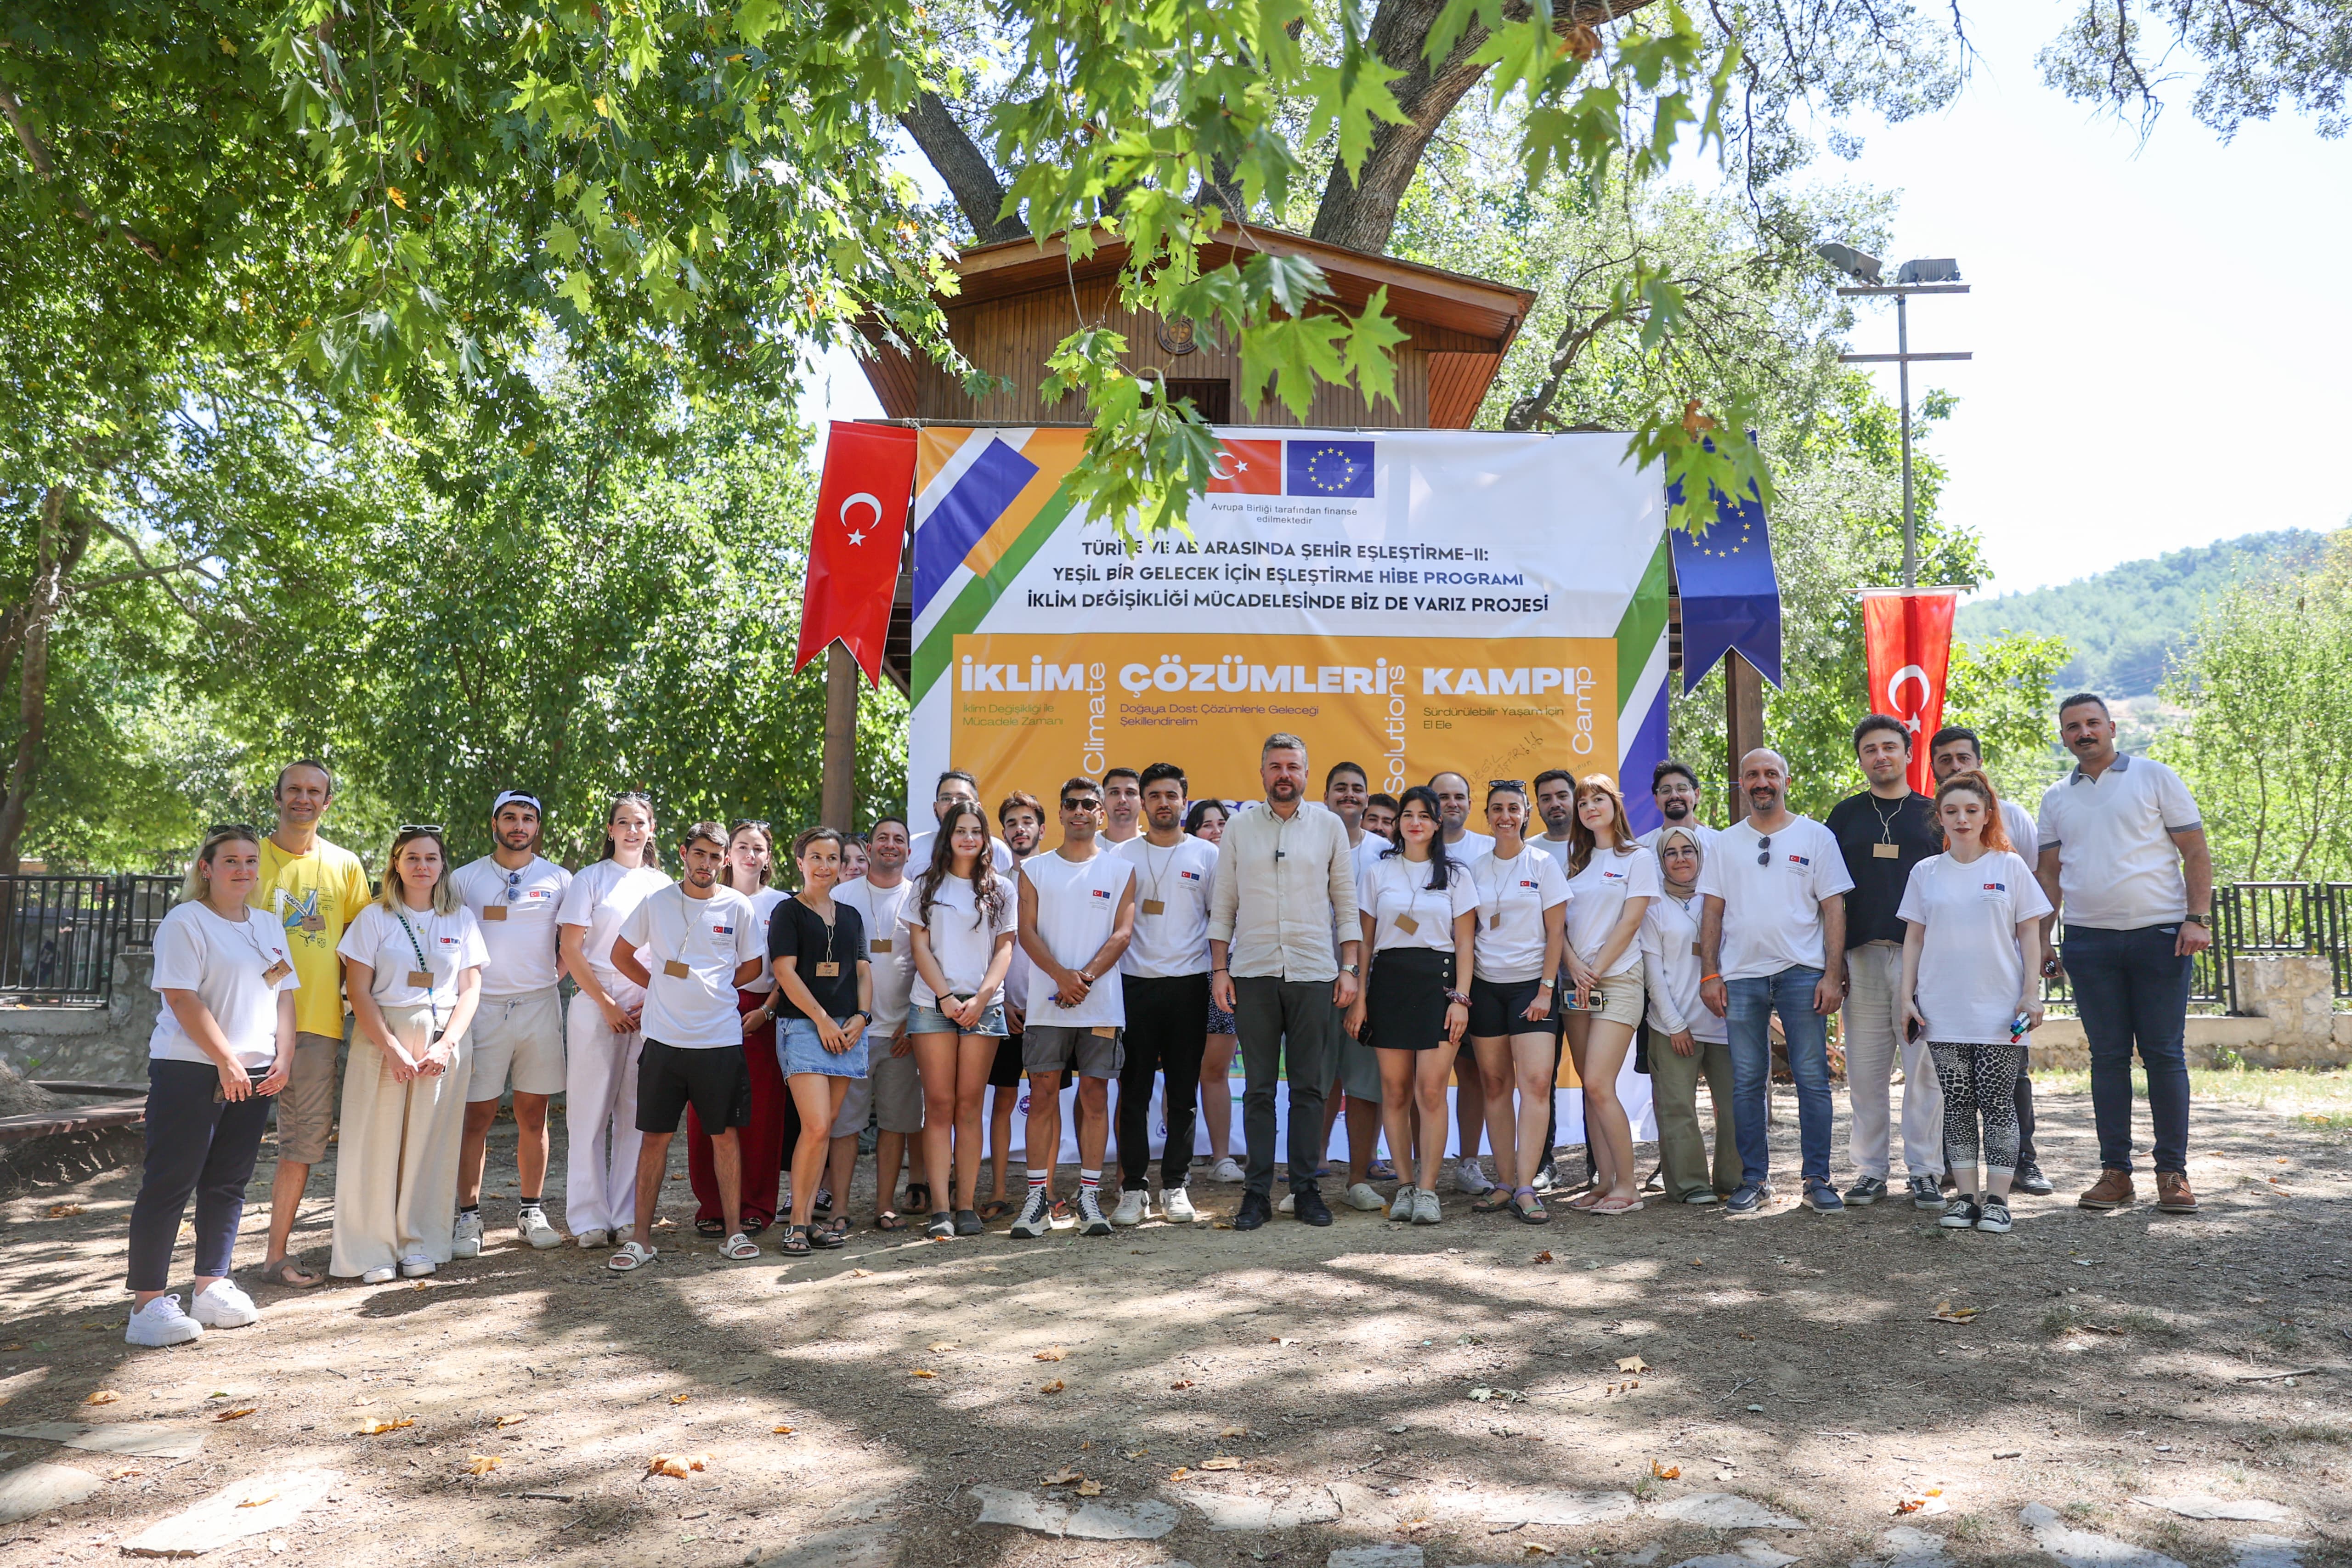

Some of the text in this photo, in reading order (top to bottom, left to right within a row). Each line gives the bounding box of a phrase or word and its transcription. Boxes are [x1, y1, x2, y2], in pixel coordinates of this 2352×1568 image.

[1211, 503, 1357, 515] Avrupa Birliği tarafından finanse
[1257, 515, 1312, 524] edilmektedir
[1204, 541, 1295, 556] ARASINDA
[1302, 541, 1351, 560] ŞEHİR
[1053, 563, 1523, 586] YEŞİL BİR GELECEK İÇİN EŞLEŞTİRME HİBE PROGRAMI
[1028, 589, 1549, 612] İKLİM DEĞİŞİKLİĞİ MÜCADELESİNDE BİZ DE VARIZ PROJESİ
[961, 654, 1575, 698] İKLİM ÇÖZÜMLERİ KAMPI
[963, 702, 1054, 715] İklim Değişikliği ile
[1120, 704, 1319, 717] Doğaya Dost Çözümlerle Geleceği
[1423, 707, 1498, 717] Sürdürülebilir
[1501, 707, 1543, 718] Yaşam
[1572, 666, 1597, 755] Camp
[963, 717, 1063, 726] Mücadele Zamanı
[1083, 662, 1105, 775] Climate
[1120, 716, 1198, 727] Şekillendirelim
[1423, 720, 1452, 730] El Ele
[1384, 665, 1405, 795] Solutions
